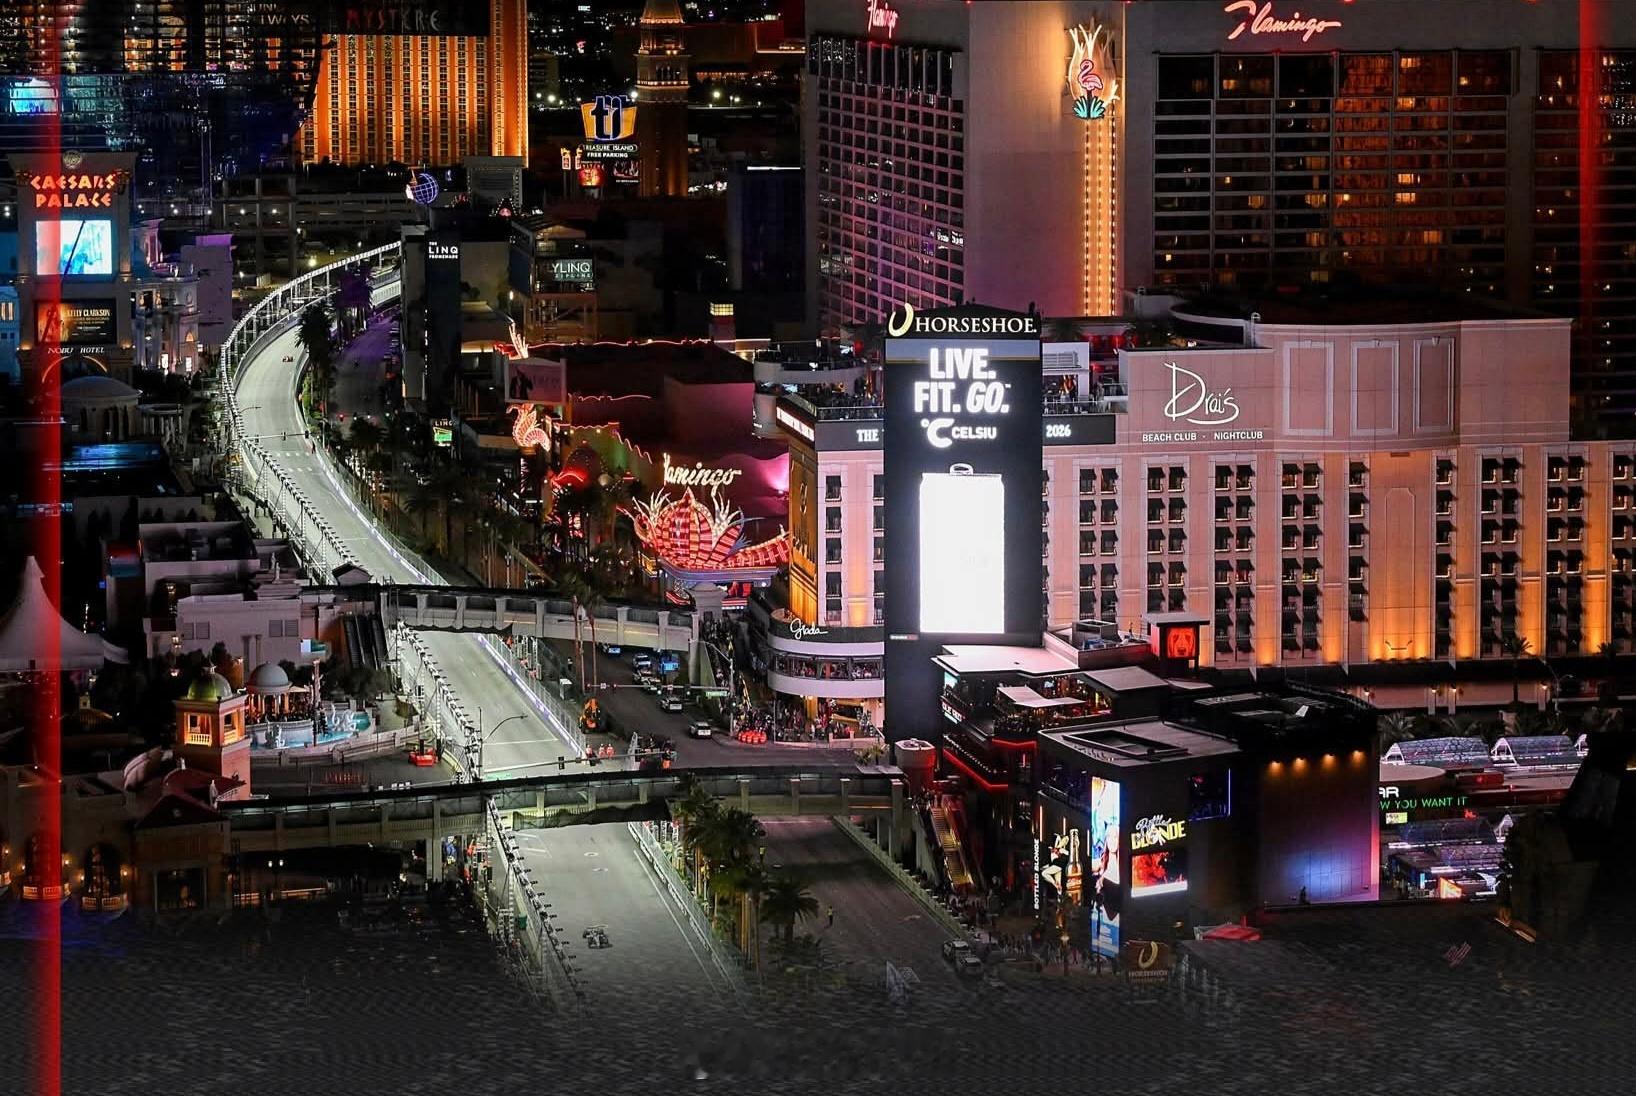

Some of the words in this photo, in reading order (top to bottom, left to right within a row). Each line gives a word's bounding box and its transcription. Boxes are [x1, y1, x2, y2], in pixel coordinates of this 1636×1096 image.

[1223, 0, 1342, 42] Flamingo
[583, 144, 610, 152] REASURE
[30, 174, 115, 190] CAESARS
[36, 192, 112, 208] PALACE
[428, 246, 458, 254] LINQ
[80, 346, 105, 354] HOTEL
[930, 348, 997, 379] LIVE.
[914, 381, 961, 413] FIT.
[856, 429, 879, 442] THE
[1046, 424, 1071, 438] 2026
[1142, 432, 1171, 442] BEACH
[1174, 432, 1197, 441] CLUB
[1214, 431, 1263, 441] NIGHTCLUB
[1395, 800, 1417, 809] YOU
[1421, 796, 1454, 808] WANT
[1457, 796, 1468, 806] IT
